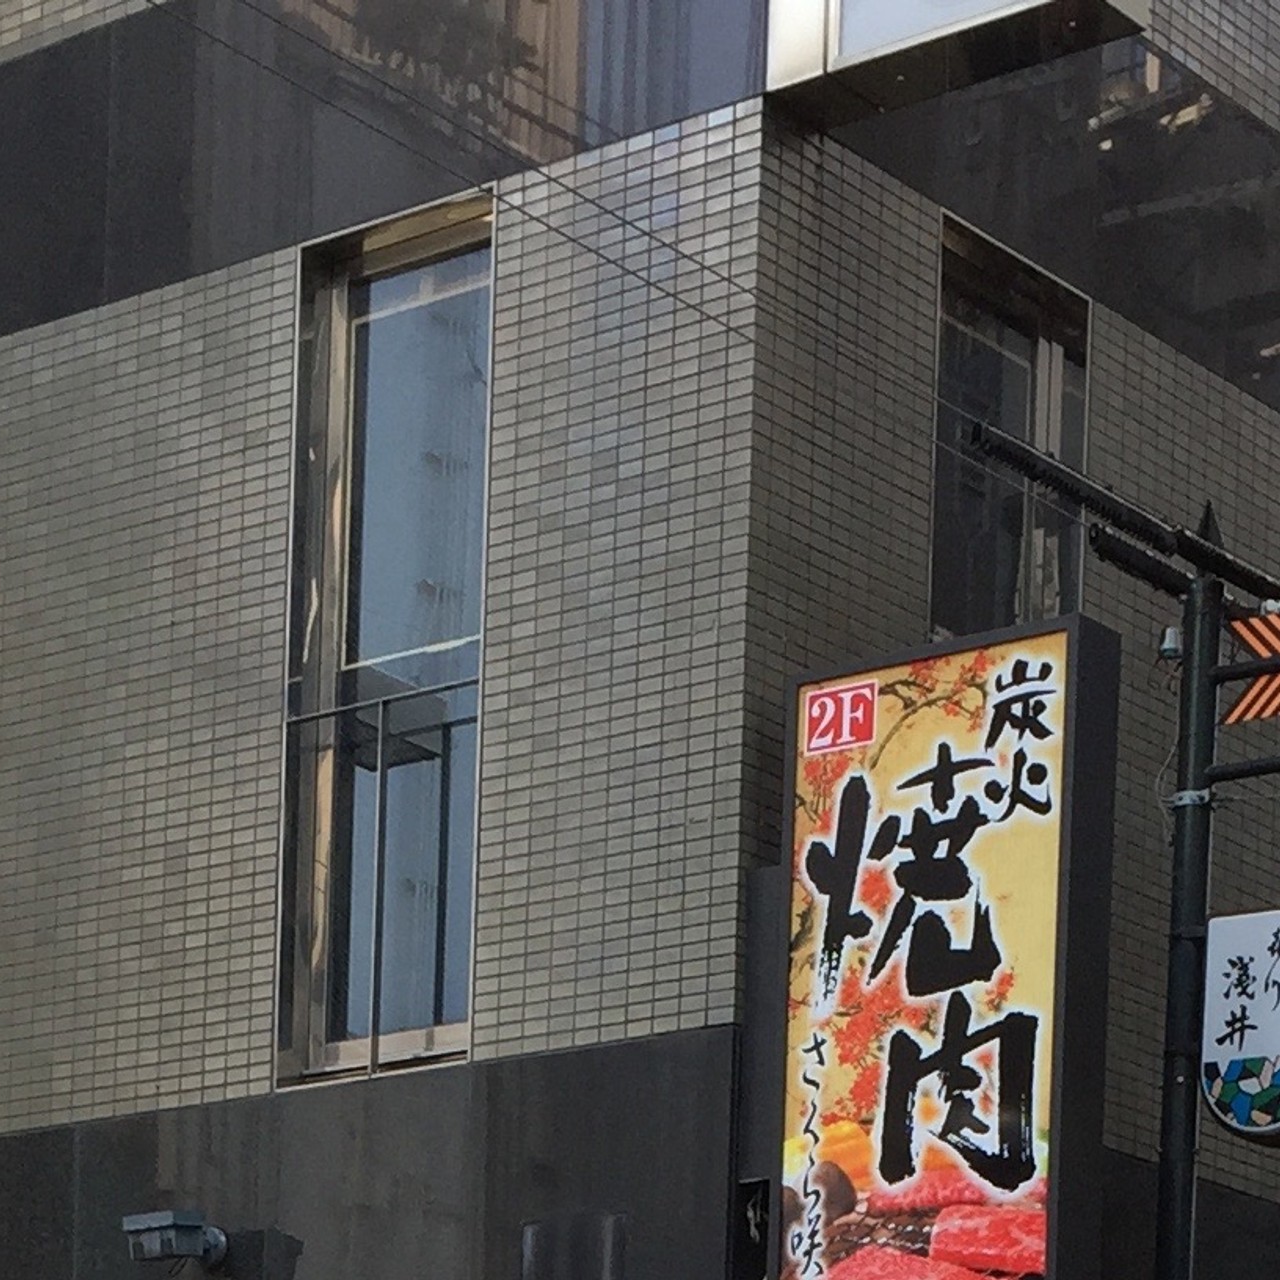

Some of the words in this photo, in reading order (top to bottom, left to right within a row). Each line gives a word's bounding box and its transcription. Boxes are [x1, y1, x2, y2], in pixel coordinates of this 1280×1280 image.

[809, 687, 873, 749] 2F
[984, 658, 1057, 822] 炭火
[806, 741, 1038, 1192] 焼肉
